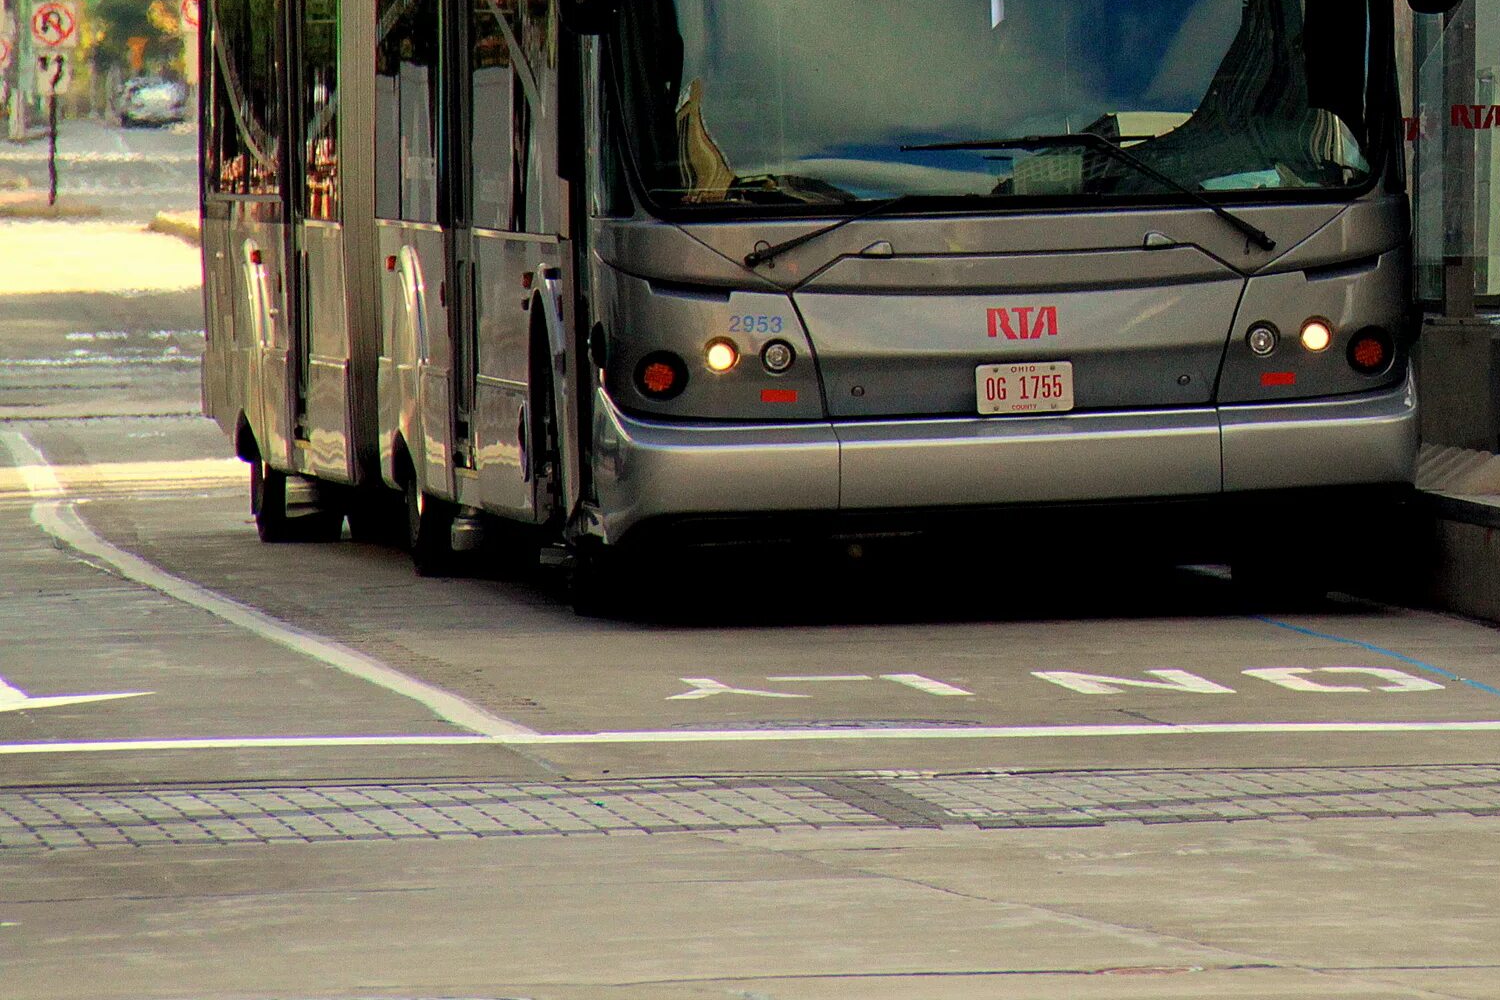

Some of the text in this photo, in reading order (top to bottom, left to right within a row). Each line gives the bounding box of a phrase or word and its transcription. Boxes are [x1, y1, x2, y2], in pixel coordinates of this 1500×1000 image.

[729, 315, 782, 333] 2953
[986, 306, 1058, 340] RTA
[1019, 375, 1063, 400] 1755
